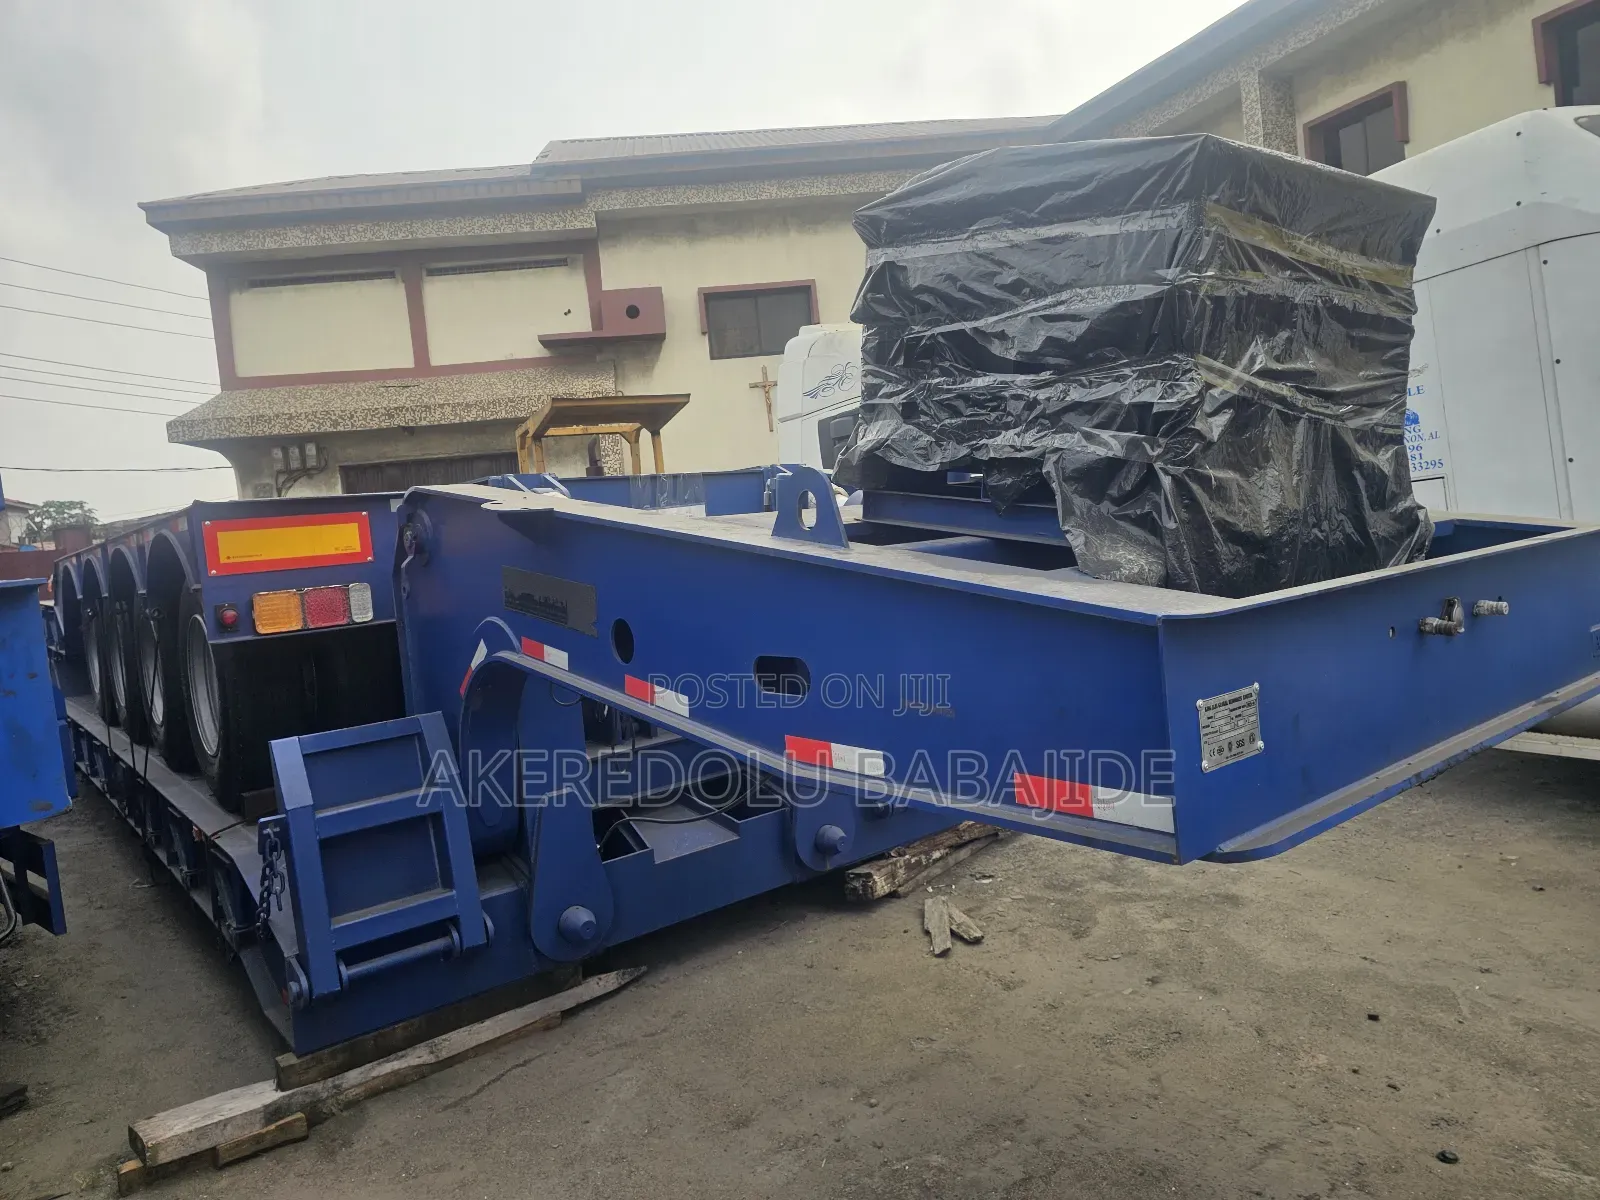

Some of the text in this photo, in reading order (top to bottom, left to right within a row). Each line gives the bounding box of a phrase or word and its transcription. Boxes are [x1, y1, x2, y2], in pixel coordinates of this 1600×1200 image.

[1428, 430, 1440, 440] AL
[1408, 442, 1423, 453] 96
[1410, 452, 1423, 462] 81
[1411, 458, 1444, 473] 33295
